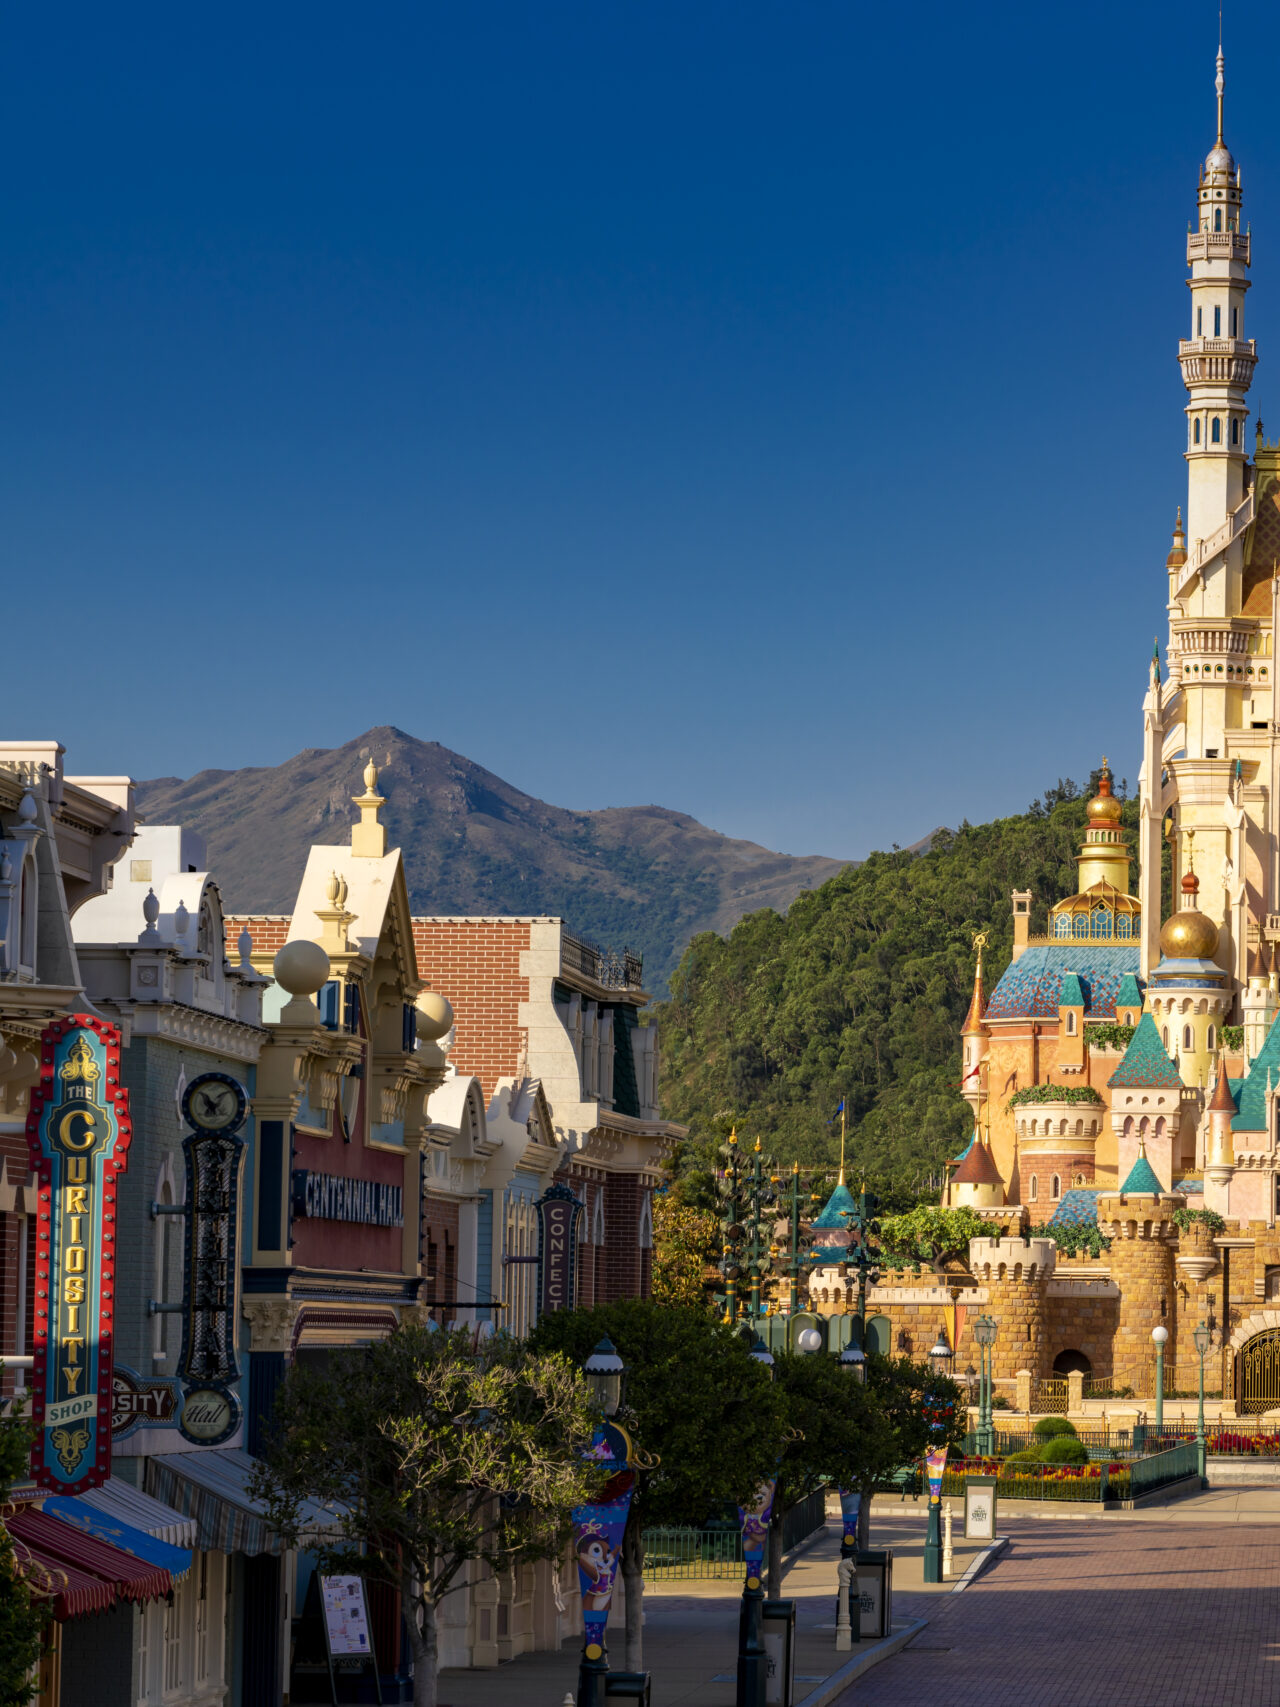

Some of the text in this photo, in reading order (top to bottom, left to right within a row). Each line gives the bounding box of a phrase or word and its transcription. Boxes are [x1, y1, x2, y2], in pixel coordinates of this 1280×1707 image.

[67, 1085, 93, 1100] THE
[306, 1171, 379, 1225] CENTENNIAL
[60, 1110, 95, 1394] CURIOSITY
[50, 1399, 93, 1421] SHOP
[186, 1404, 228, 1424] Hall
